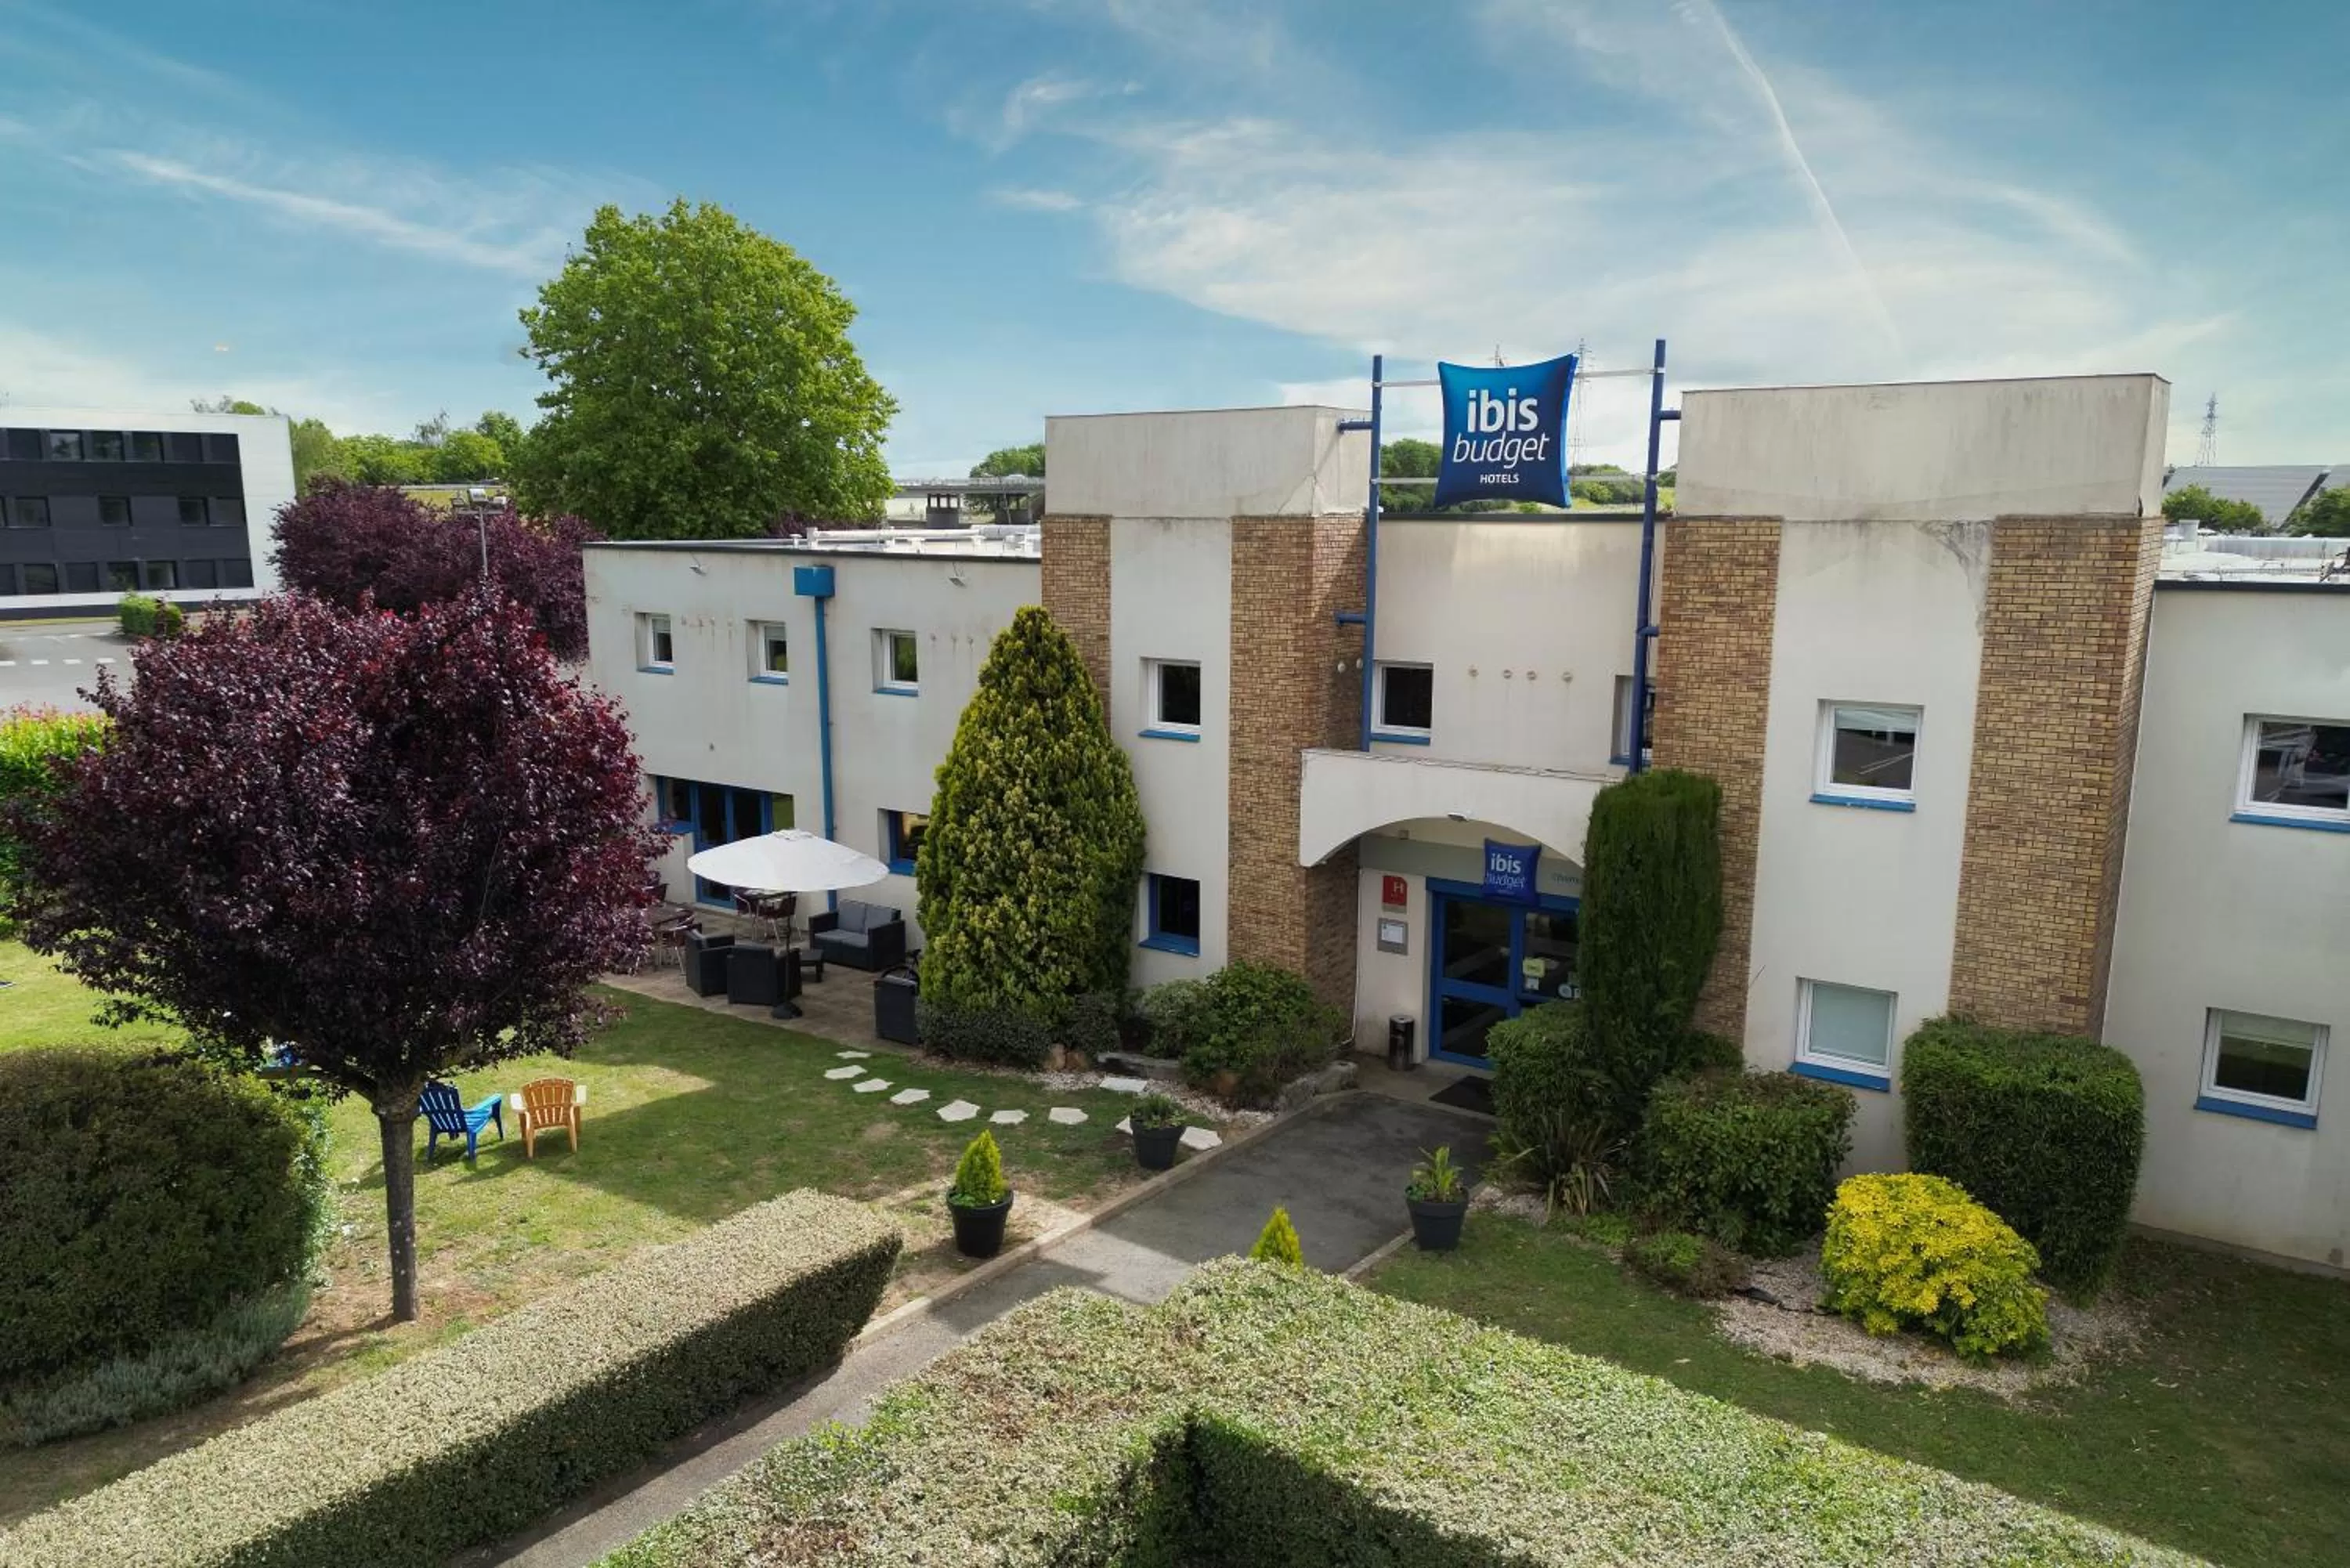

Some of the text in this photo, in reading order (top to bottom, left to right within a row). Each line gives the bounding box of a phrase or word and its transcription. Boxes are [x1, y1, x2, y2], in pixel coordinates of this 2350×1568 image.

[1467, 388, 1538, 432] ibis
[1453, 431, 1550, 469] budget
[1480, 473, 1520, 484] HOTELS
[1491, 852, 1522, 874] ibis
[1394, 881, 1405, 894] H
